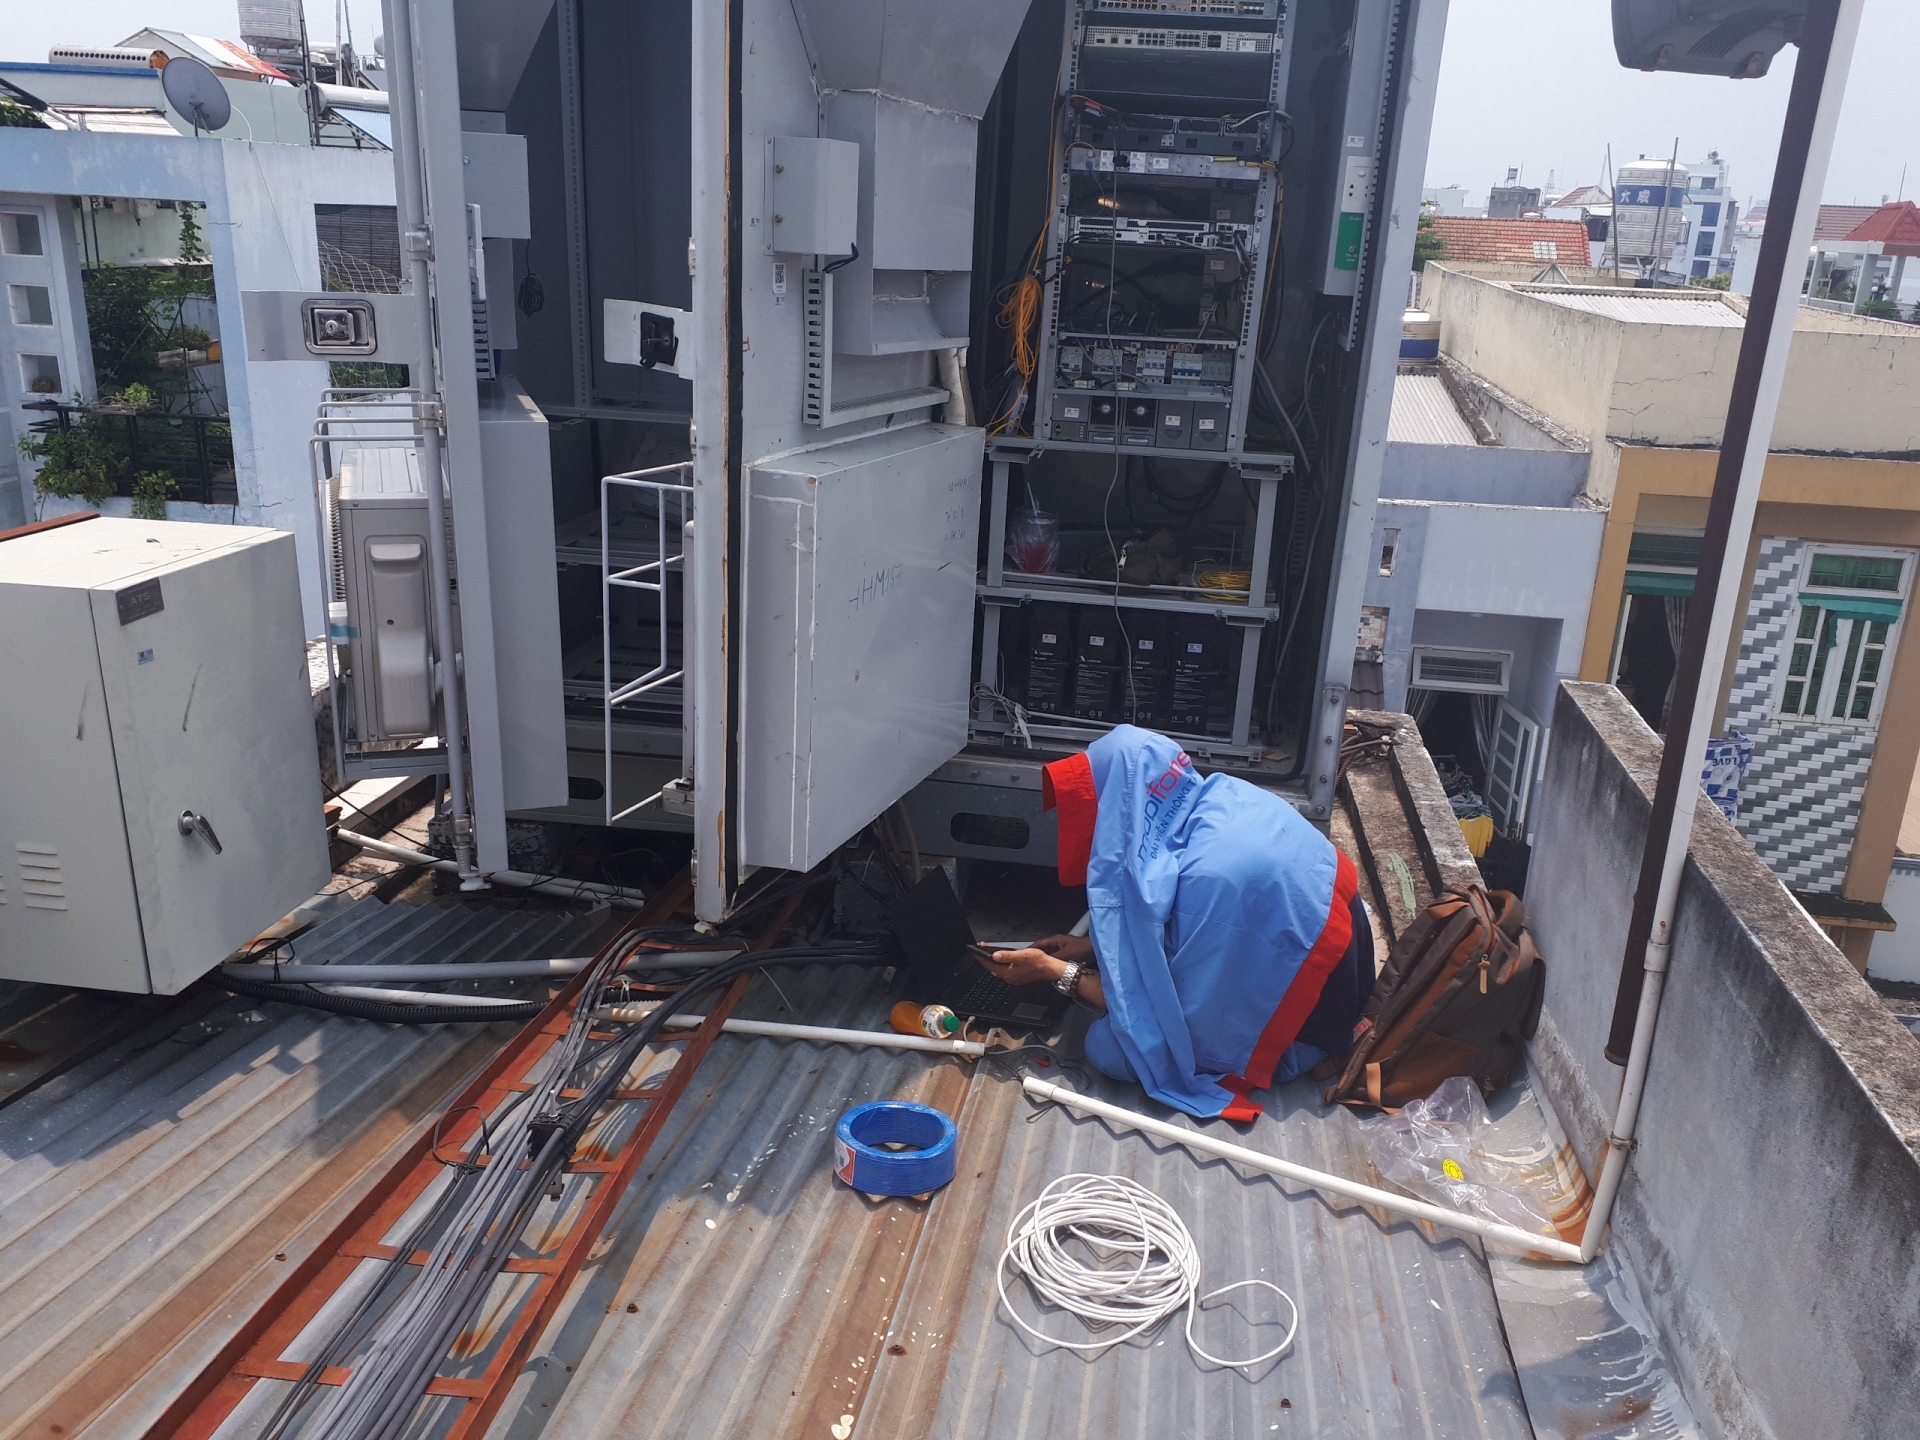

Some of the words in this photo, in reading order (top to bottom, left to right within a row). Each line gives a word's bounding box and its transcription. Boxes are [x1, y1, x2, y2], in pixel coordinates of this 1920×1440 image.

[130, 592, 150, 604] ATS
[1712, 757, 1737, 767] LOVE
[1165, 787, 1191, 820] THÔNG
